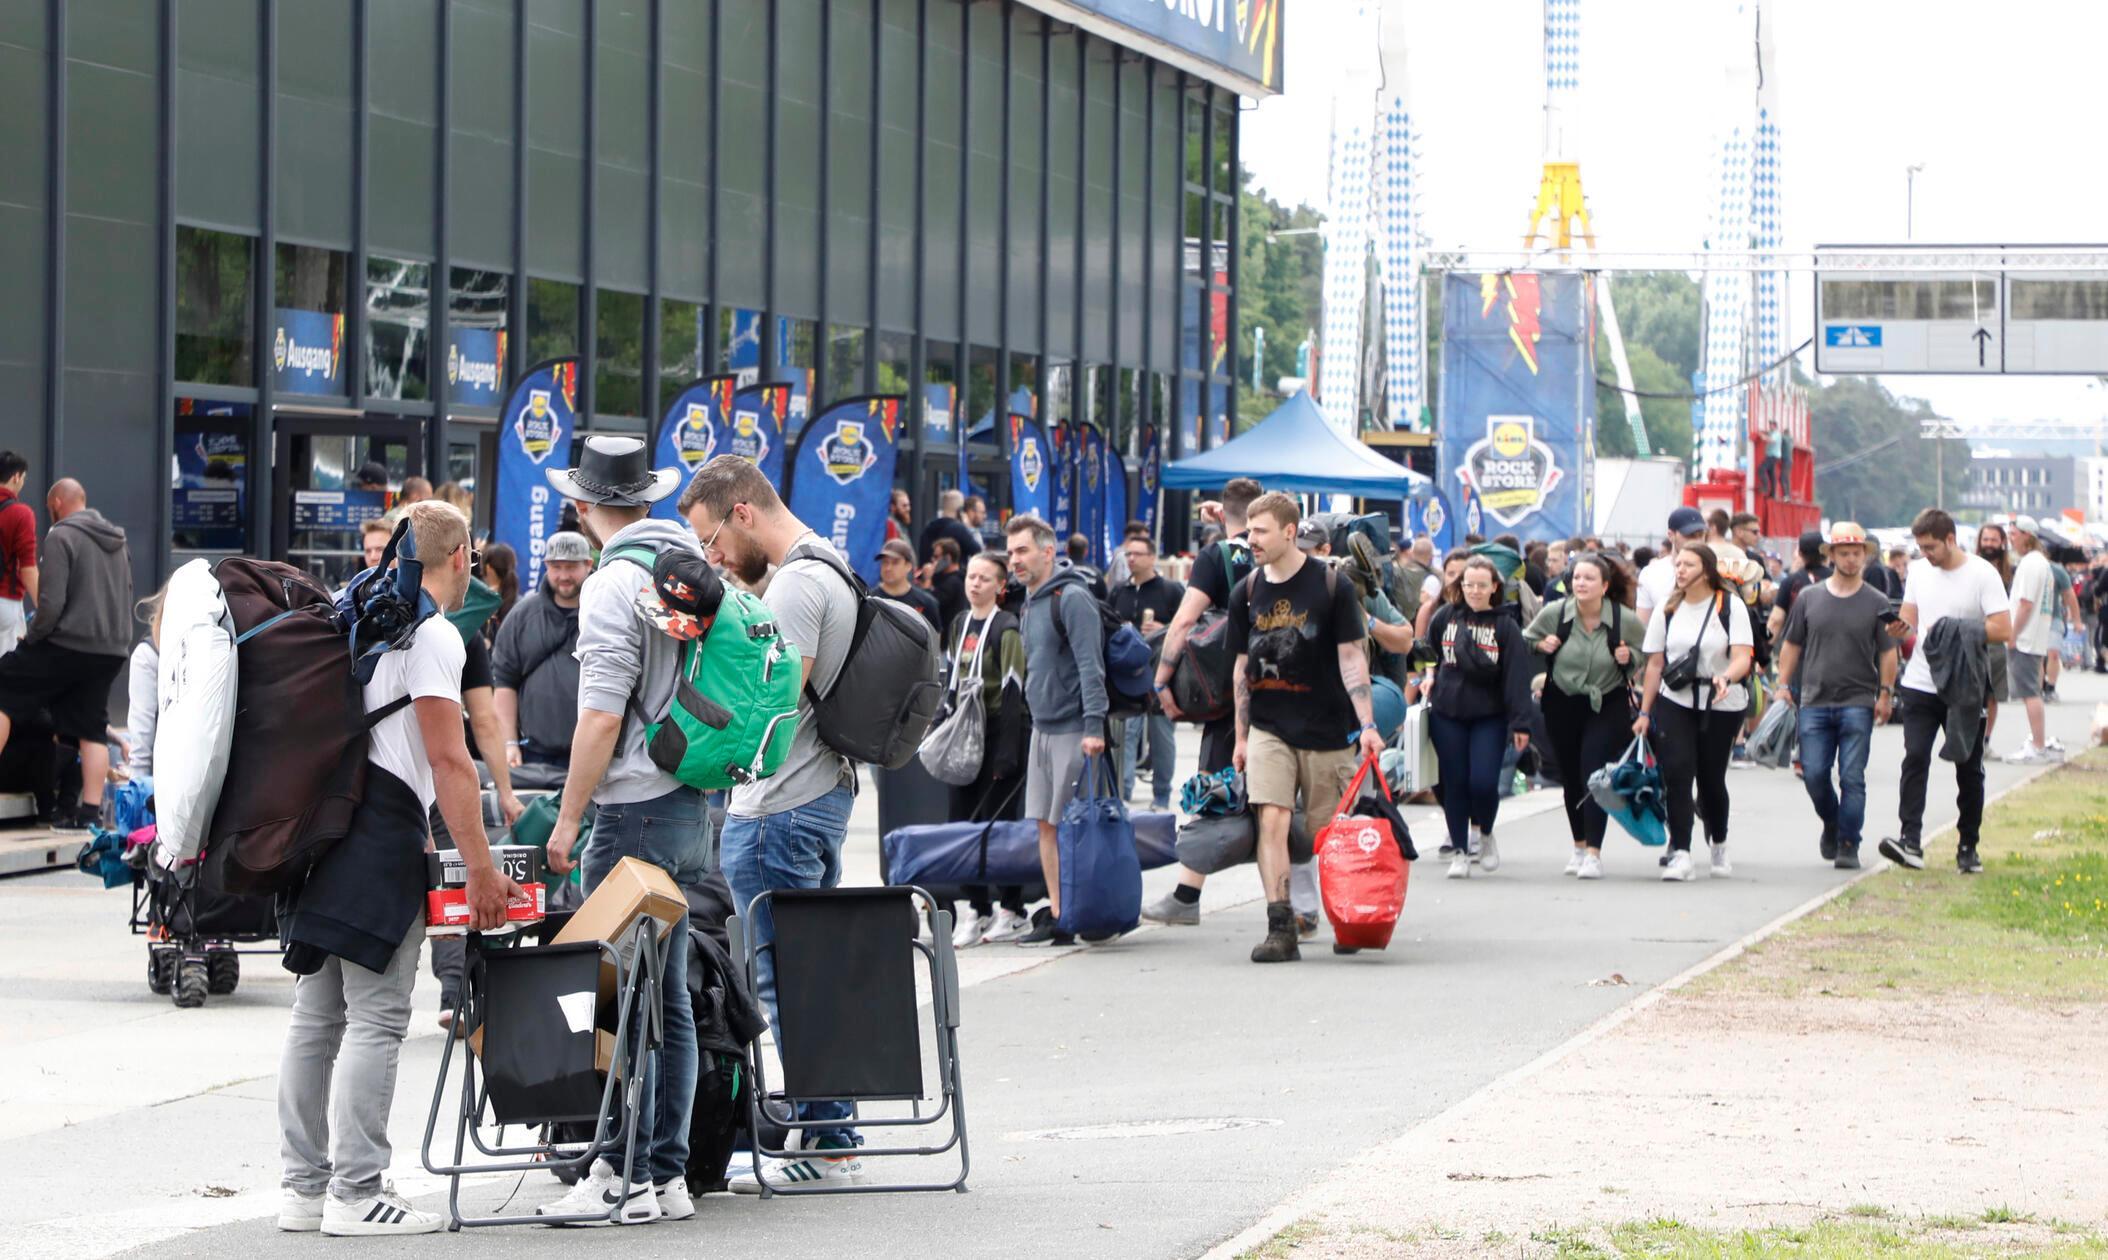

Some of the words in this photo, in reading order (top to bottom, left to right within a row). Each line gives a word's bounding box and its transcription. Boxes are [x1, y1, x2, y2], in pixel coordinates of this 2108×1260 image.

[287, 337, 331, 379] Ausgang
[458, 354, 496, 392] Ausgang
[1481, 474, 1538, 488] STORE
[1482, 460, 1536, 475] ROCK
[528, 486, 549, 591] usgang
